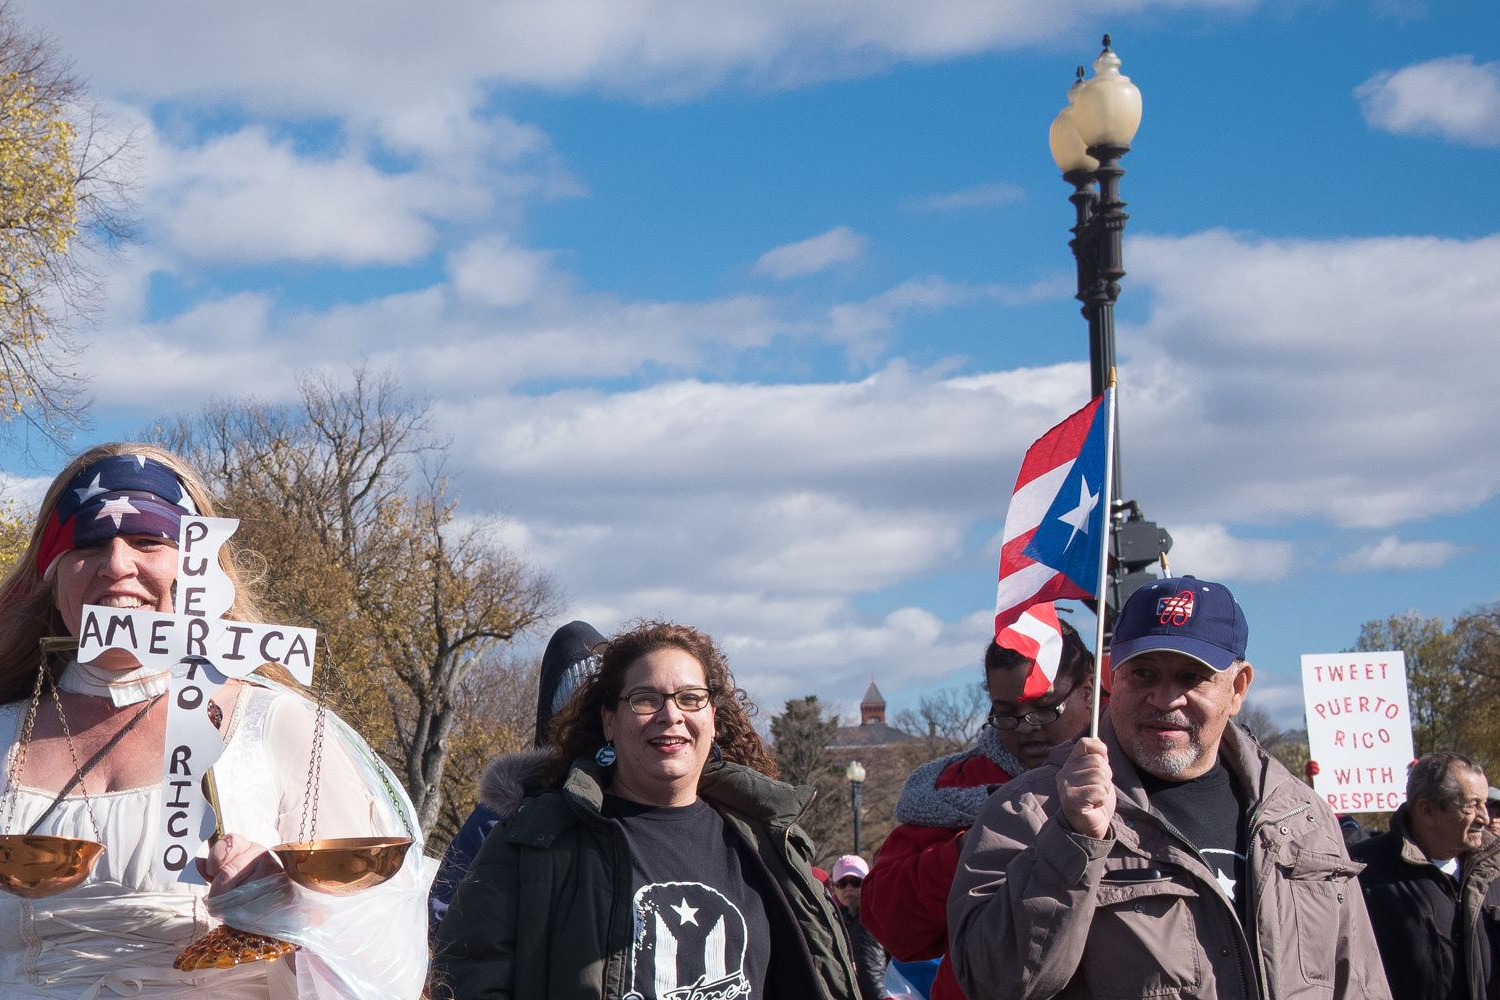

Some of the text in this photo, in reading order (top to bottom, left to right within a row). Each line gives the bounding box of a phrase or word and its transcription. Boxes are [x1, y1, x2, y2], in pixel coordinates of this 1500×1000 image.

[178, 521, 210, 710] PUERTO
[79, 611, 311, 668] AMERICA
[1314, 663, 1388, 682] TWEET
[1314, 696, 1400, 719] PUERTO
[1334, 728, 1391, 749] RICO
[1334, 767, 1393, 785] WITH
[164, 745, 192, 872] RICO
[1327, 792, 1407, 810] RESPEC
